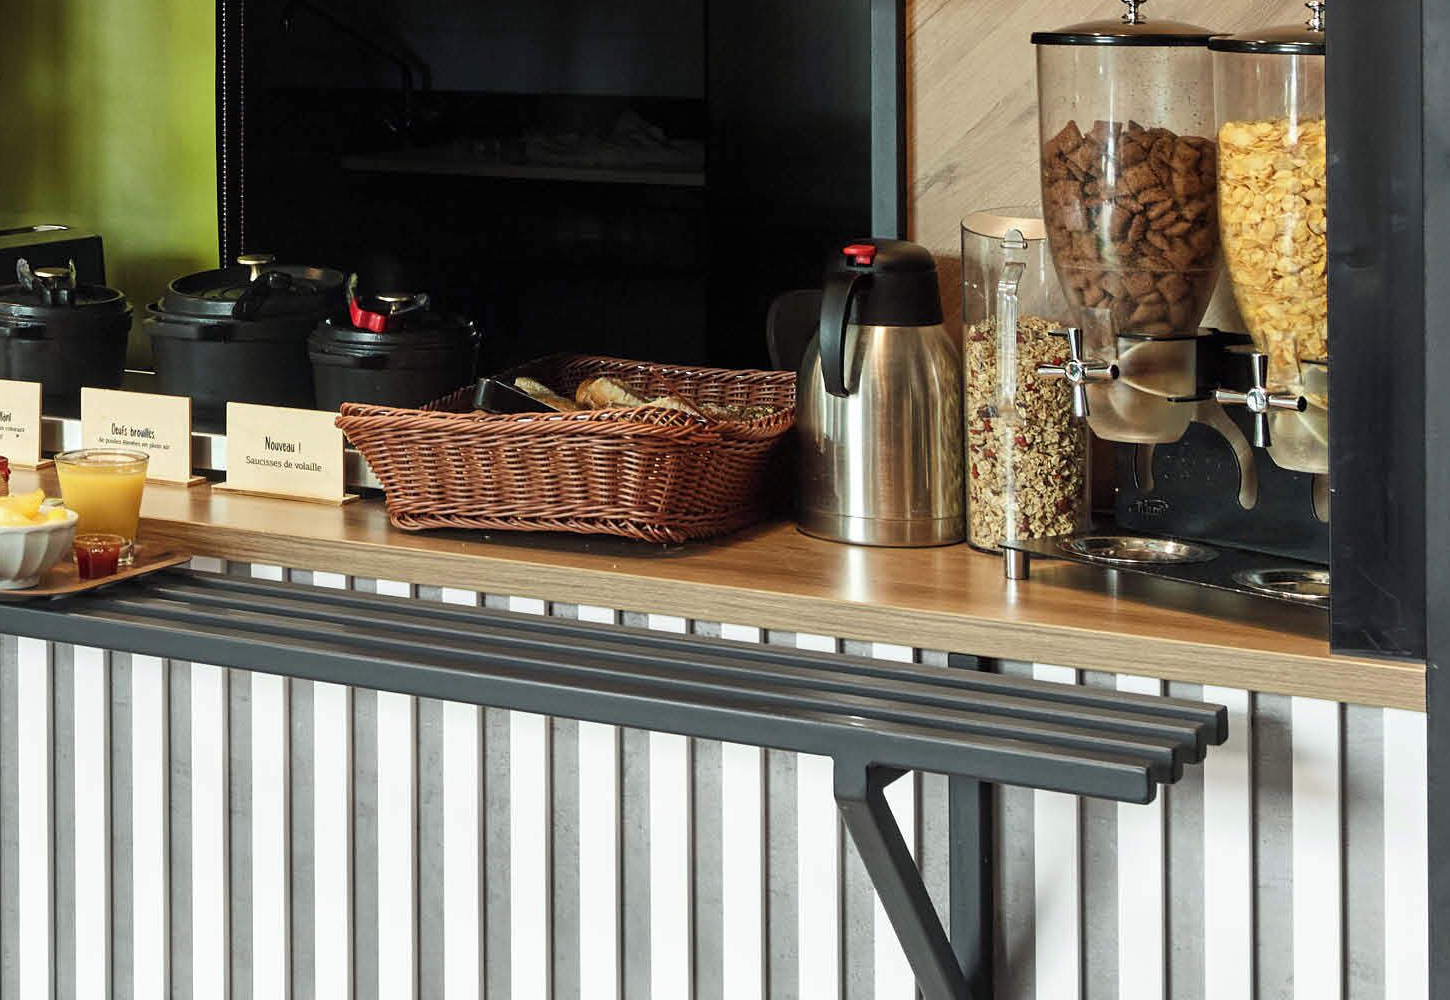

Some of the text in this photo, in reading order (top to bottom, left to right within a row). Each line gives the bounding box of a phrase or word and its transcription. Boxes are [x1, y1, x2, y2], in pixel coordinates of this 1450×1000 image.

[264, 436, 295, 453] Nouveau
[246, 456, 322, 472] Saucisses de volaille
